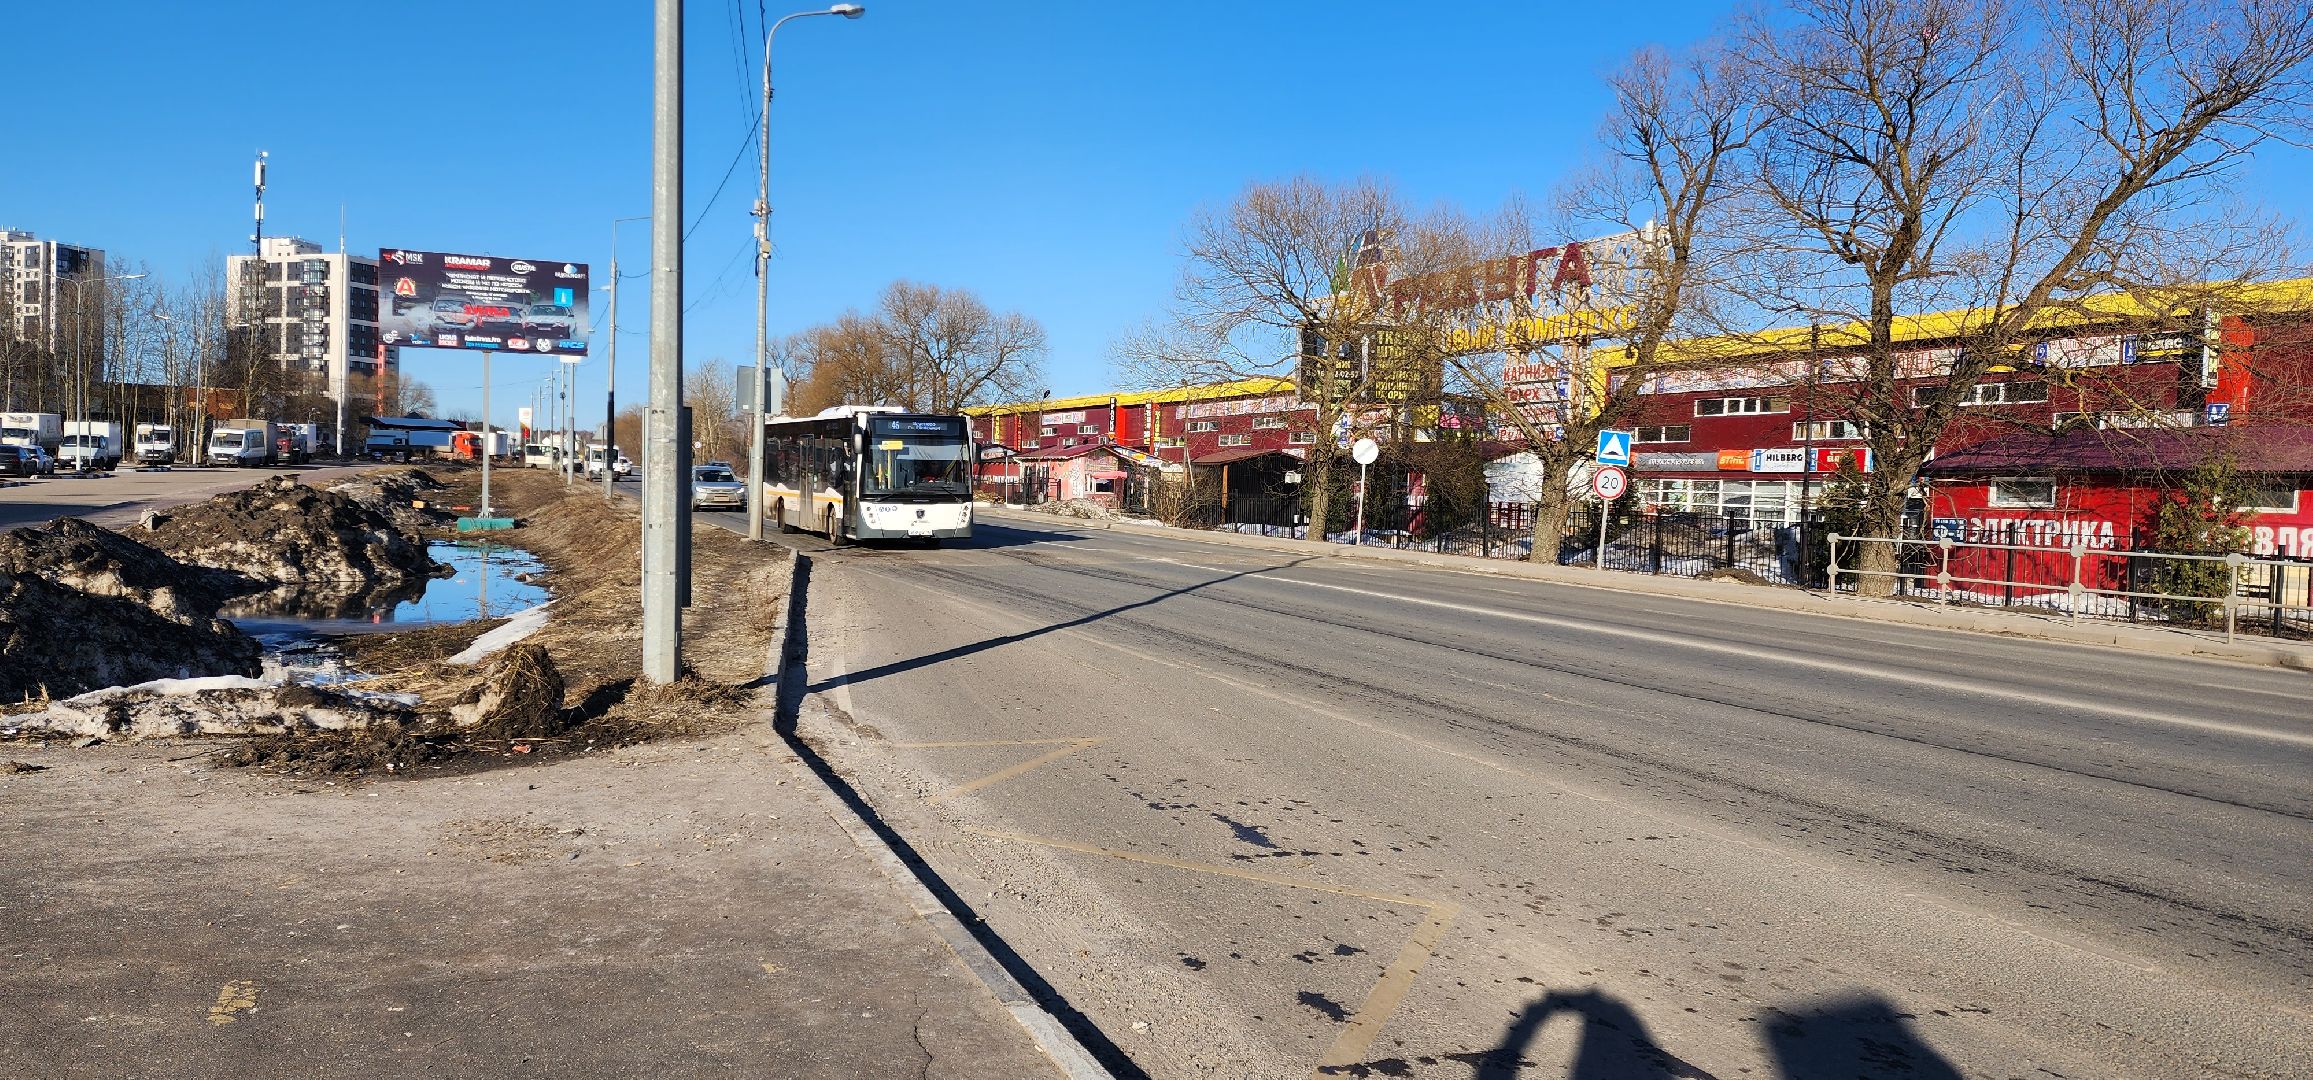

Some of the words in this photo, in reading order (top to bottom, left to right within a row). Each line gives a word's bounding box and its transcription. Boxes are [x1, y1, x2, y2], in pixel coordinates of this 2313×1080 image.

[444, 255, 491, 266] KRAMAR
[1719, 455, 1745, 465] STIHL
[1766, 453, 1803, 461] HILBERG
[1601, 476, 1619, 490] 20
[1969, 517, 2115, 549] ЭЛЕКТРИКА
